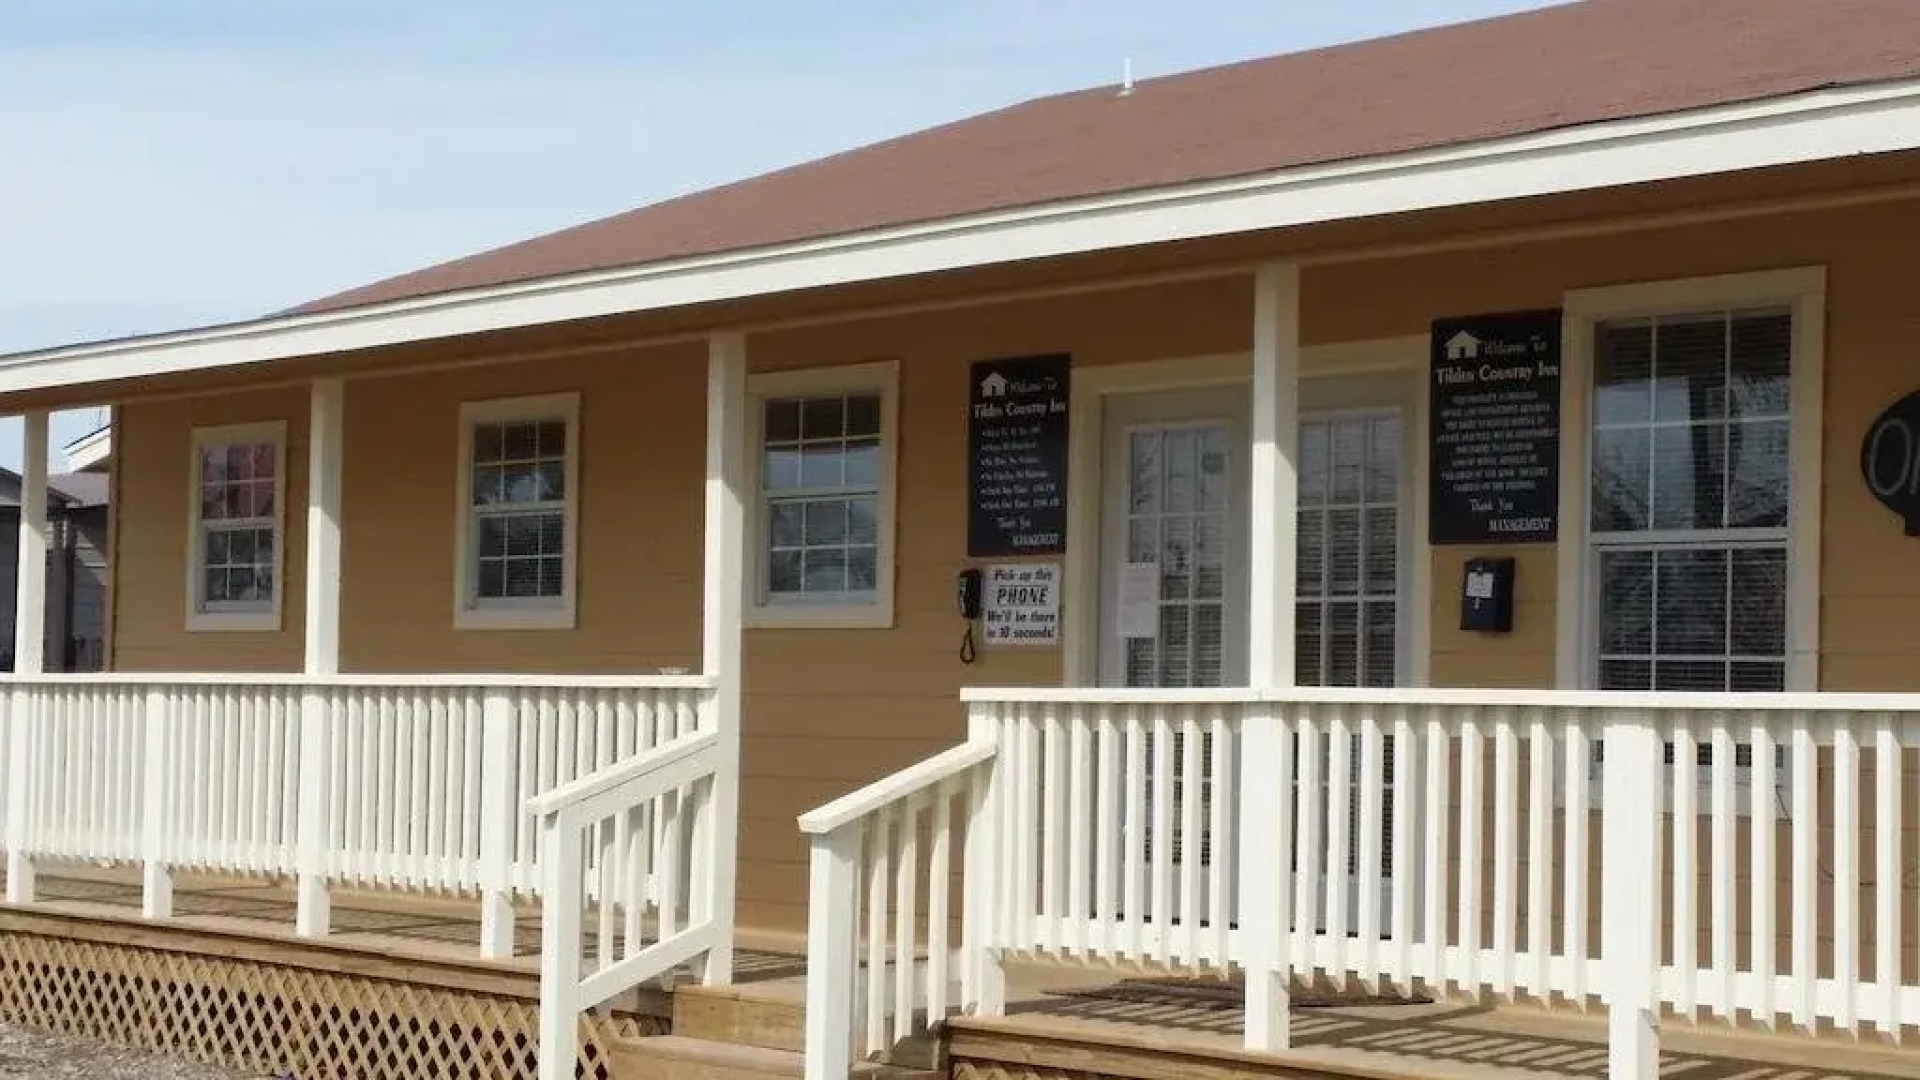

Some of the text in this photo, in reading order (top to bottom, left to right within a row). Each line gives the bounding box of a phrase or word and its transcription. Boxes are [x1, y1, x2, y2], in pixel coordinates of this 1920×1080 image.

[1436, 360, 1559, 385] Tilden Country Inn
[1005, 401, 1047, 418] Country
[1868, 418, 1920, 496] O
[1469, 498, 1493, 511] Thank
[1488, 517, 1551, 532] MANAGEMENT
[992, 568, 1015, 581] Pick
[997, 587, 1049, 605] PHONE
[987, 609, 1055, 622] We'll be there
[986, 625, 1056, 638] in 10 seconds!
